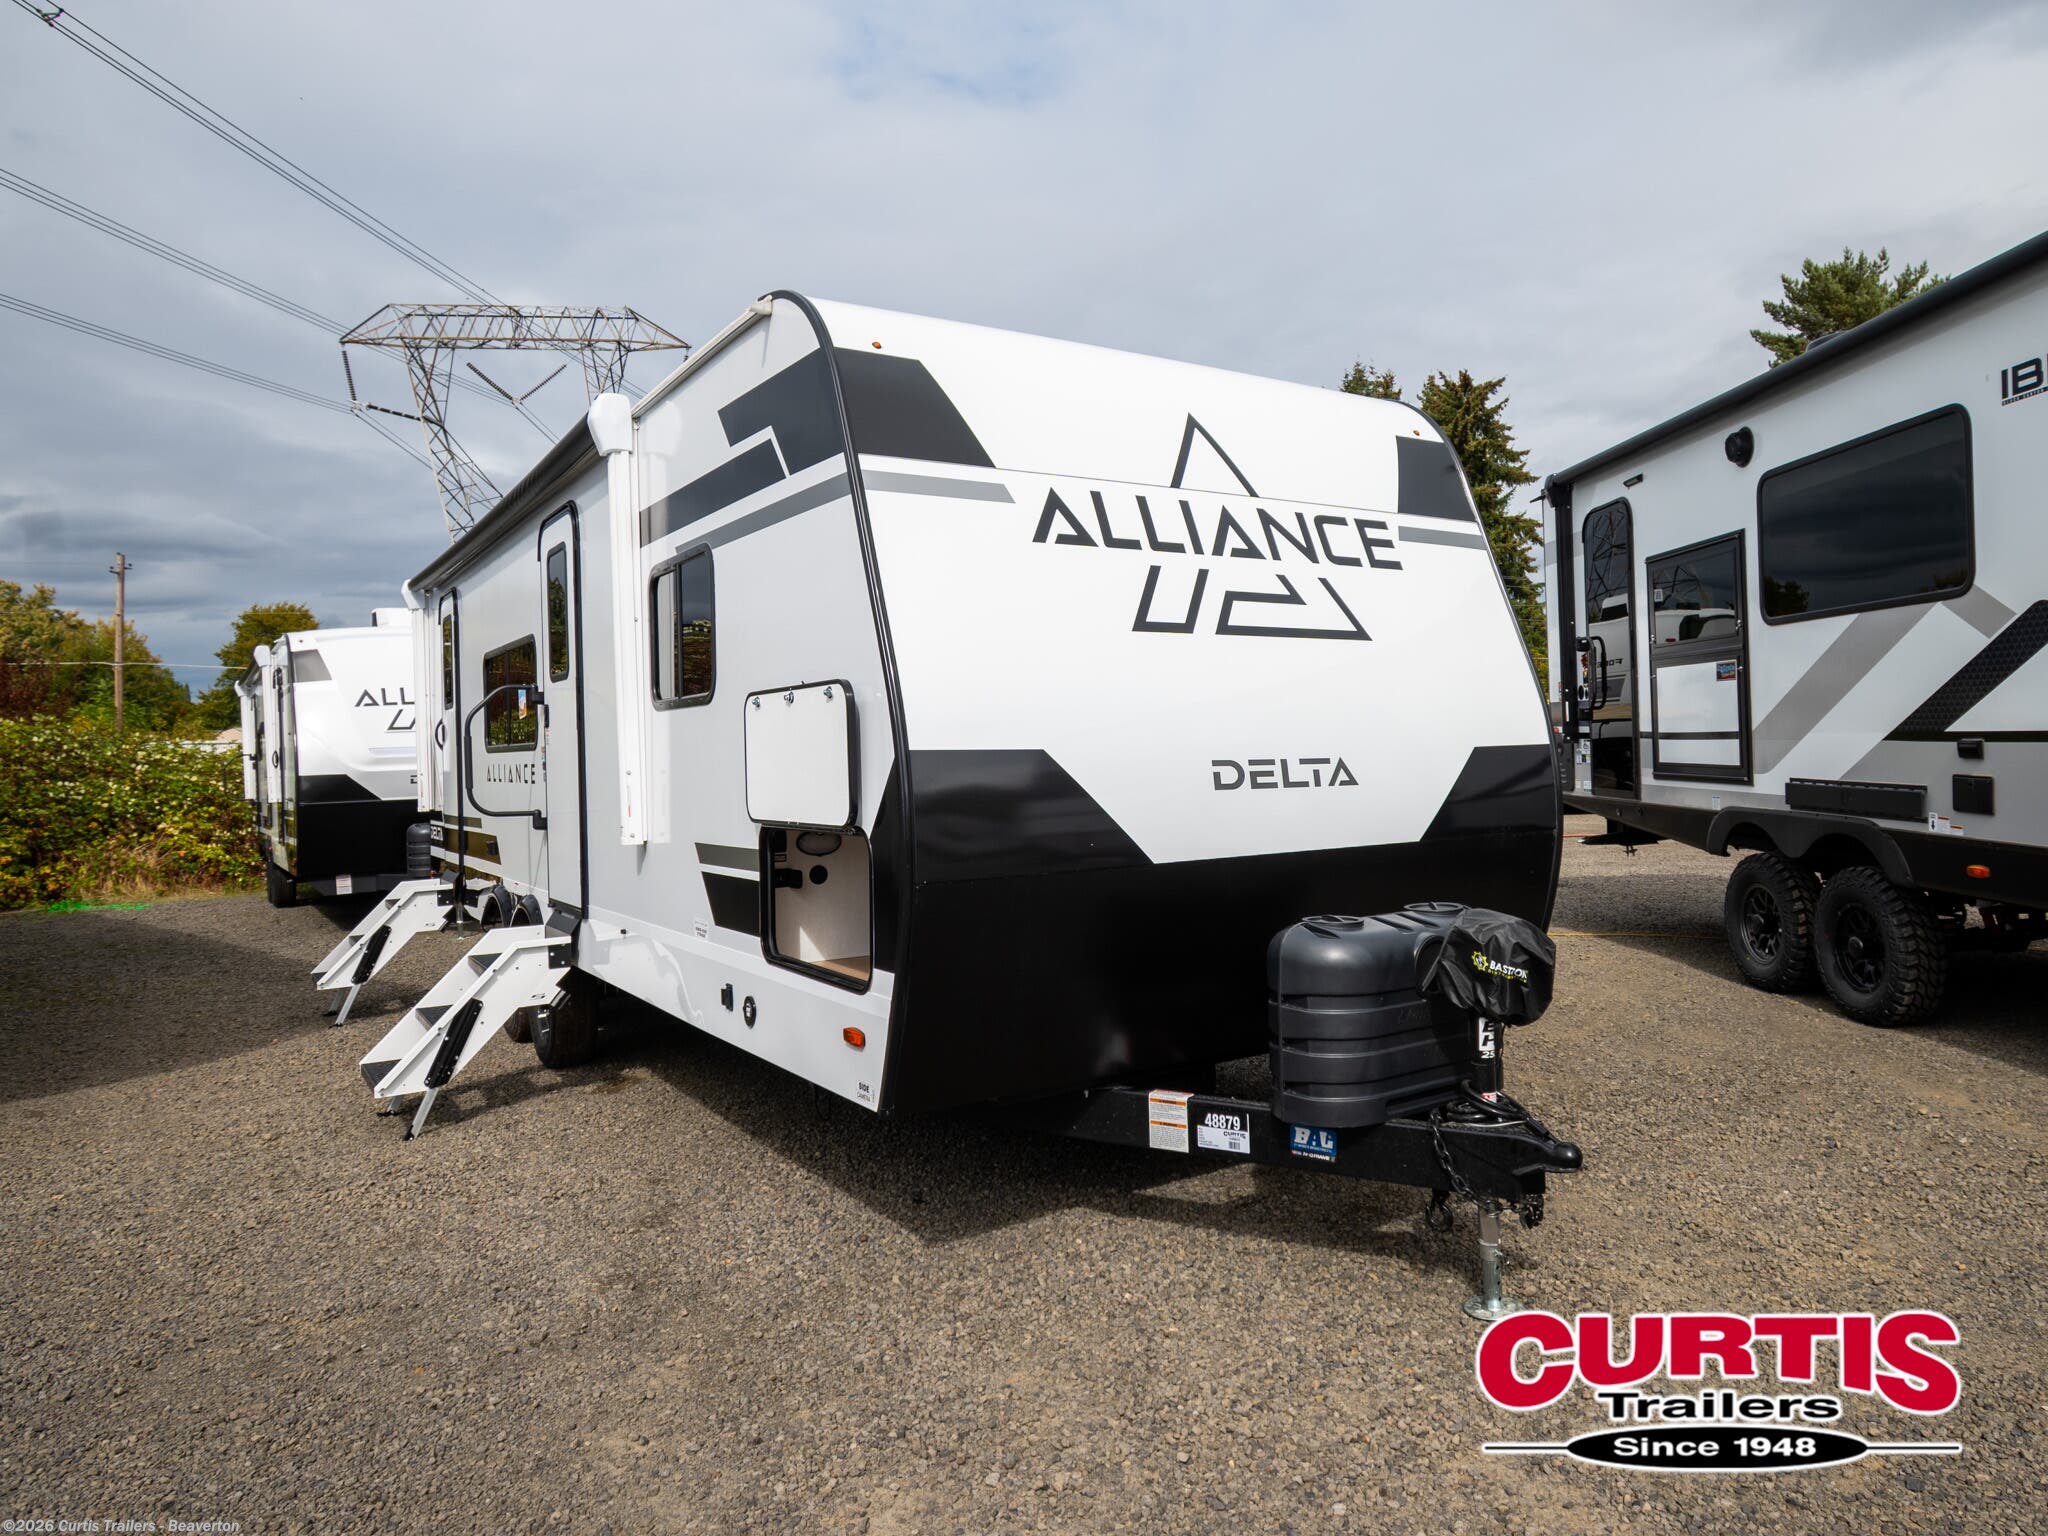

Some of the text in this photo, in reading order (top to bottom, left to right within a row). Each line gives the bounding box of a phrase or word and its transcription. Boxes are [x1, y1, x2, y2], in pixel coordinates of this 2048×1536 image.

[2001, 354, 2048, 400] IB
[1032, 486, 1404, 571] ALLIANCE
[486, 763, 536, 784] ALLIANCE
[1211, 757, 1360, 791] DELTA
[1204, 1112, 1241, 1131] 48879
